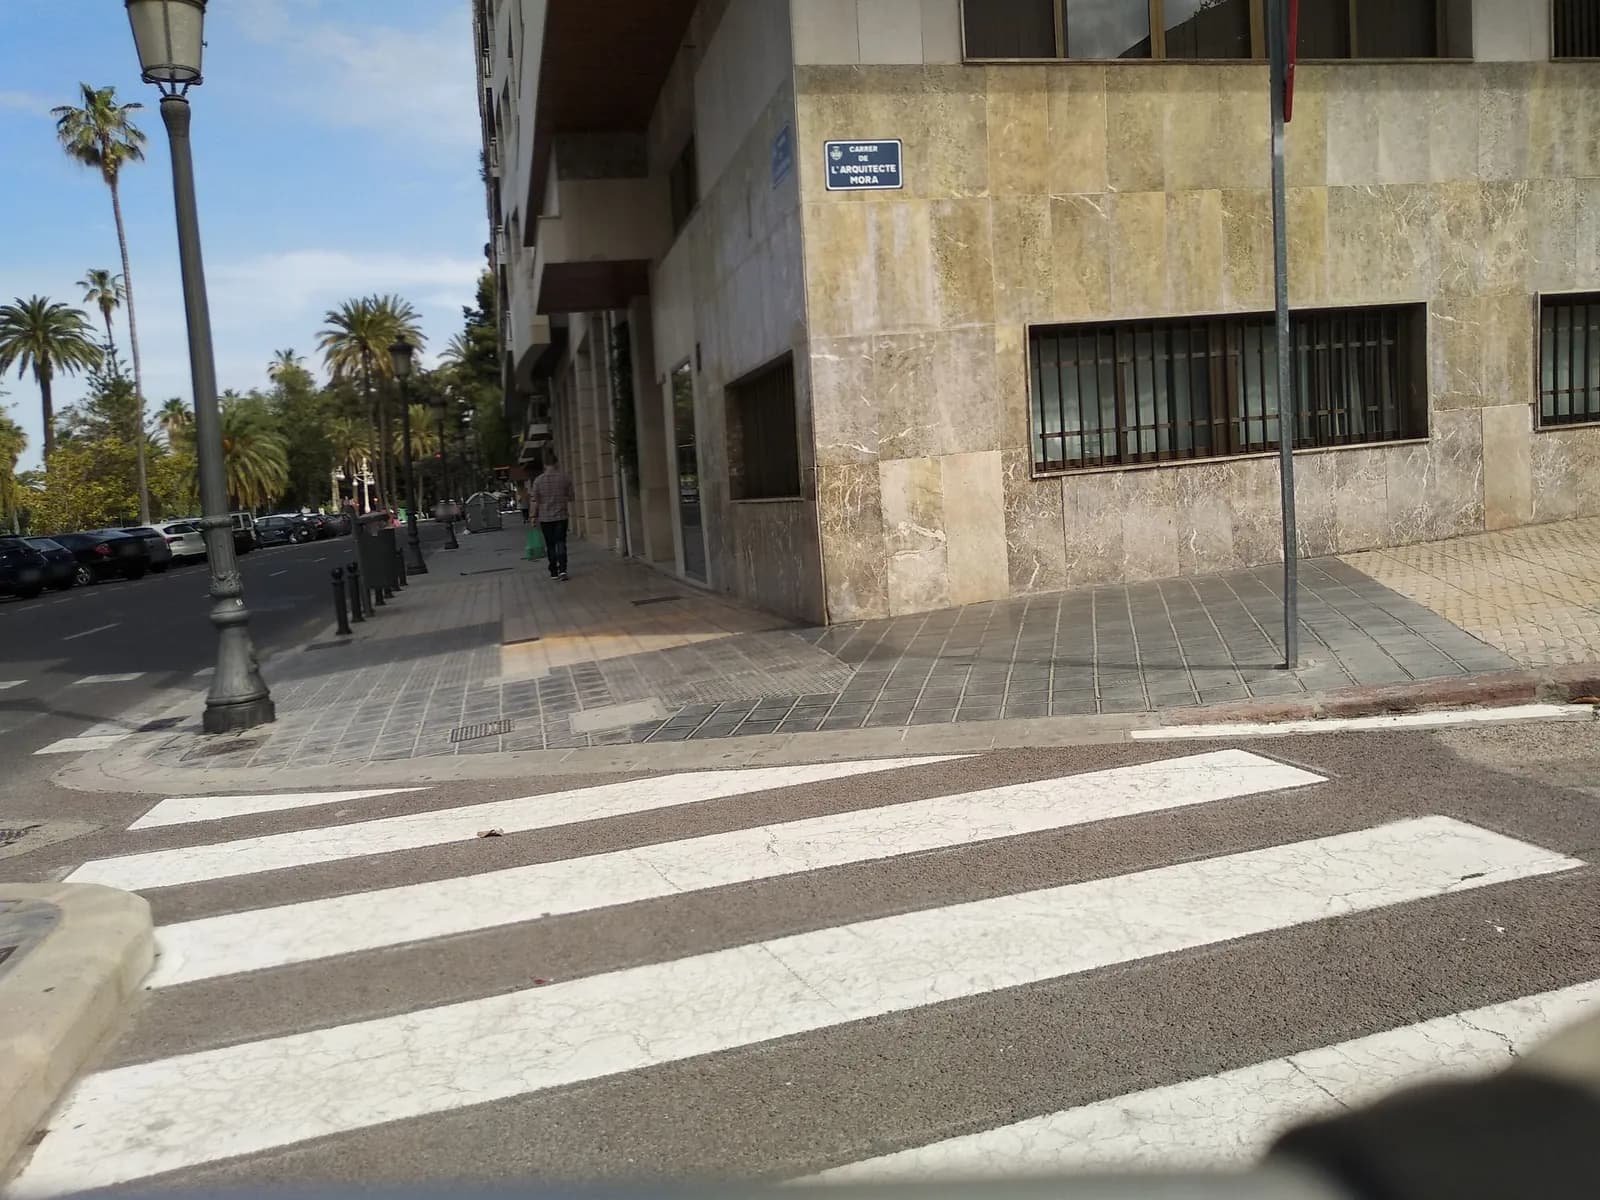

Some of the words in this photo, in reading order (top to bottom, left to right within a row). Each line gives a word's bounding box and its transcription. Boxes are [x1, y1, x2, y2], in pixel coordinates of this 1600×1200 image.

[849, 145, 878, 153] CARRER
[831, 164, 897, 174] L'ARQUITECTE
[849, 175, 879, 184] MORA
